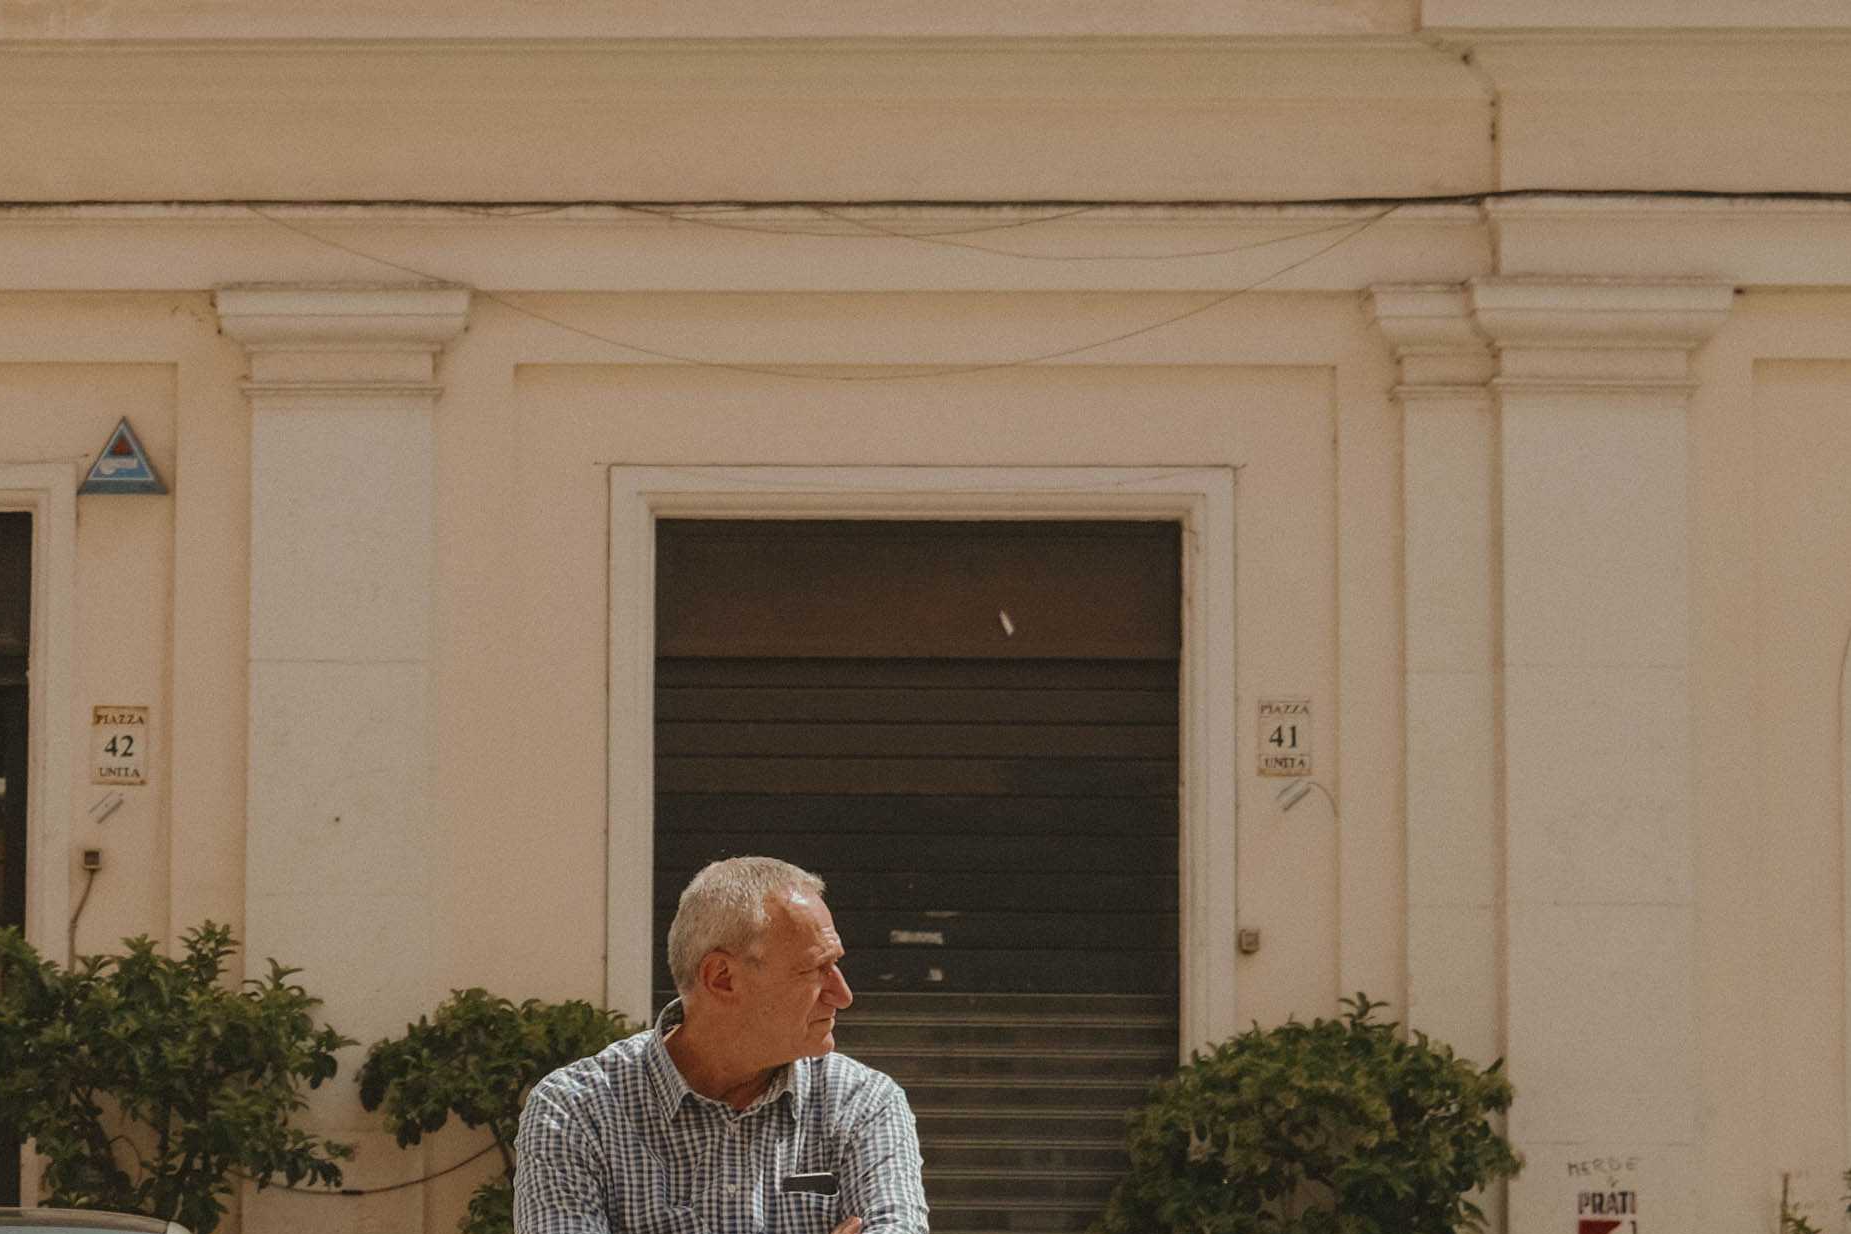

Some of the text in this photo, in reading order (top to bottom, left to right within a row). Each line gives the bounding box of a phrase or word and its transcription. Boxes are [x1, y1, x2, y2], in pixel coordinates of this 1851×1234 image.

[96, 714, 144, 725] PIAZZA
[1260, 704, 1309, 715] PIAZZA
[104, 735, 134, 757] 42
[1269, 725, 1297, 749] 41
[1577, 1190, 1637, 1215] PRATI
